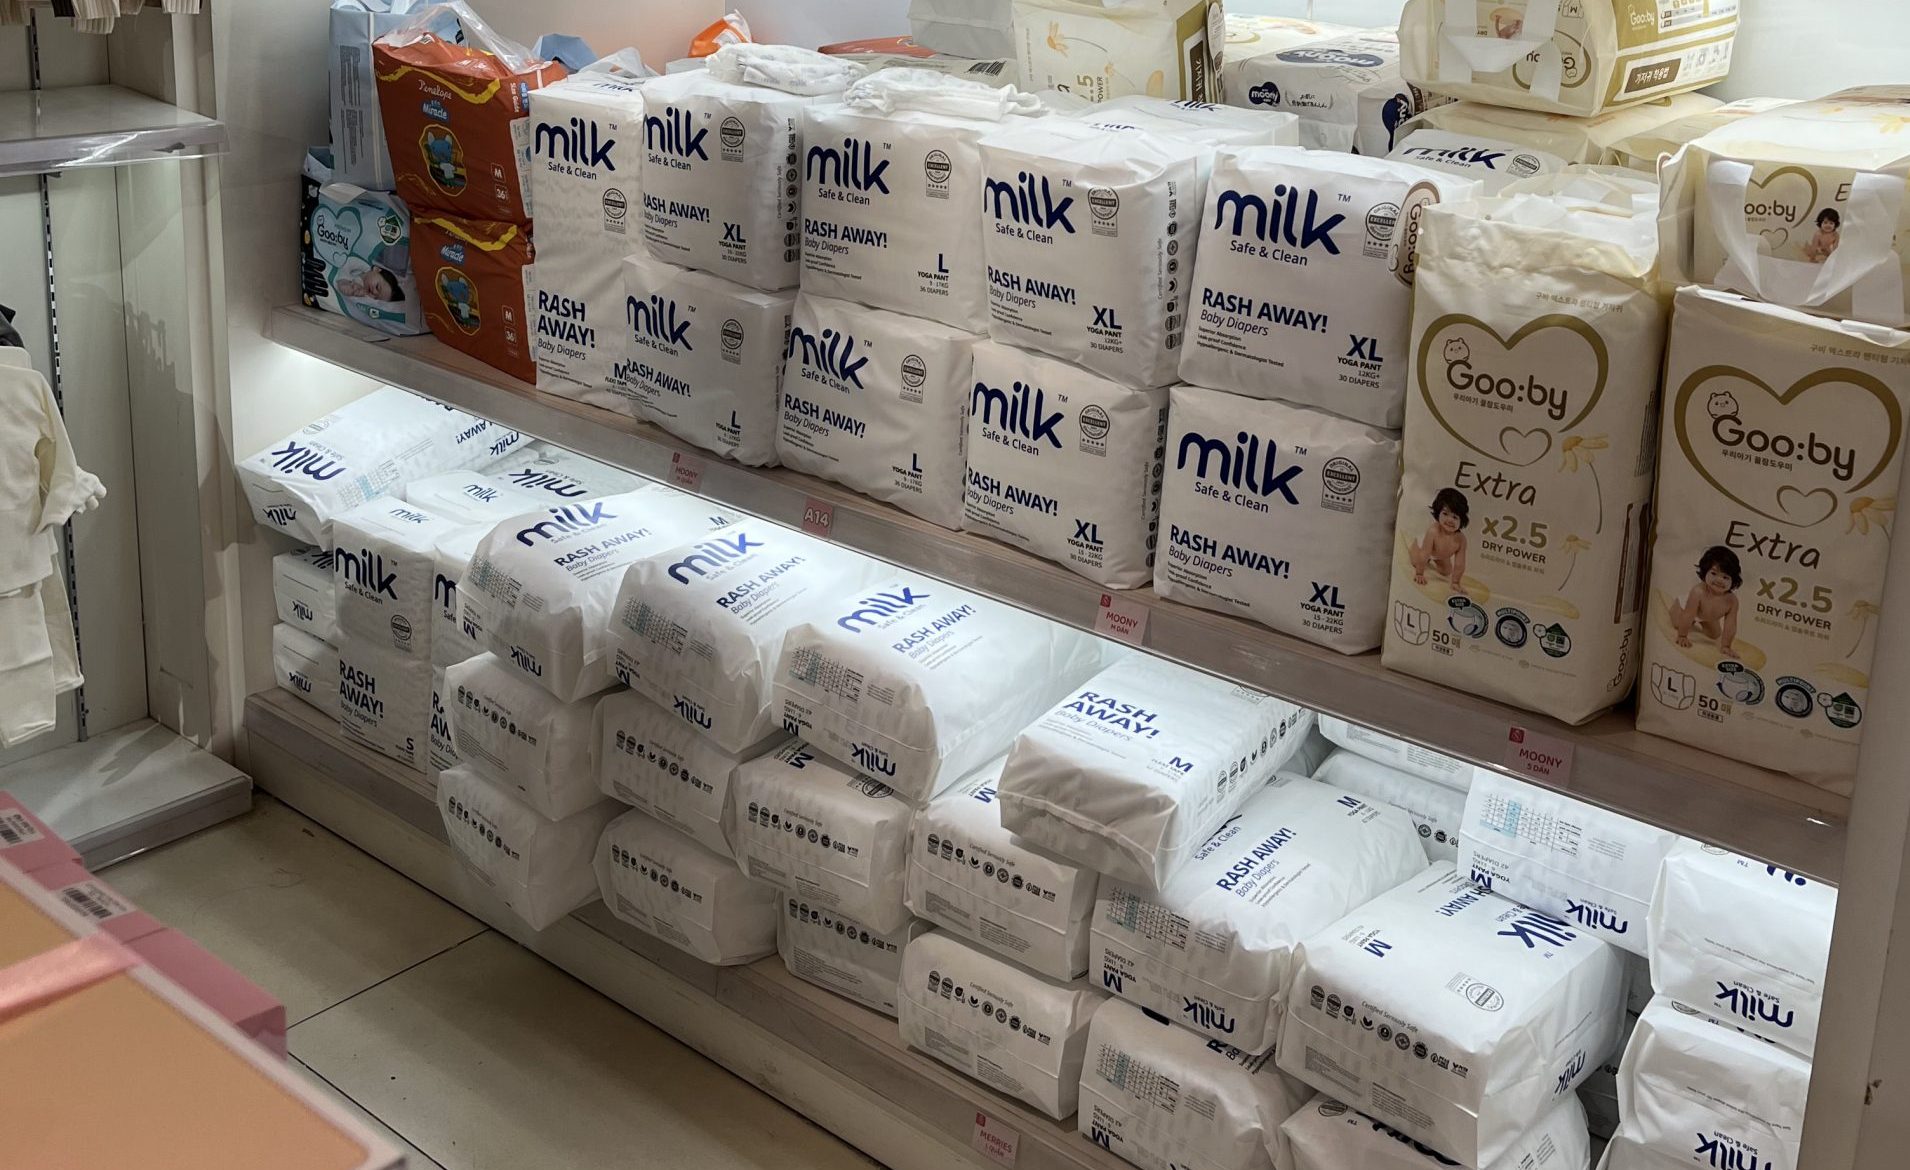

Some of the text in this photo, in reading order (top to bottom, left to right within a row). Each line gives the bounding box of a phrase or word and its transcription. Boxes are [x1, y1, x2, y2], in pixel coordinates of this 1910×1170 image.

[1630, 11, 1655, 28] Goo:by
[418, 80, 452, 100] Penelope
[1252, 90, 1278, 101] moony
[535, 117, 616, 171] milk
[643, 106, 709, 161] milk
[807, 138, 890, 194] milk
[818, 188, 870, 206] Safe & Clean
[984, 171, 1076, 234] milk
[1214, 184, 1346, 255] milk
[1744, 200, 1796, 223] oo:by
[317, 224, 349, 250] Goo:by
[724, 222, 746, 244] XL
[804, 218, 888, 248] RASH AWAY!
[804, 238, 848, 254] Baby Diapers
[938, 254, 949, 274] L
[1230, 240, 1308, 266] Safe & Clean
[988, 266, 1076, 305] RASH AWAY!
[990, 286, 1036, 309] Baby Diapers
[538, 290, 586, 322] RASH
[1092, 306, 1122, 330] XL
[1203, 288, 1328, 334] RASH AWAY!
[538, 315, 595, 348] AWAY!
[627, 294, 693, 350] milk
[1087, 326, 1122, 338] YOGA PANT
[1200, 310, 1269, 336] Baby Diapers
[538, 337, 586, 361] Baby Diapers
[789, 327, 869, 390] milk
[1346, 334, 1384, 362] XL
[1338, 356, 1382, 372] YOGA PANT
[1358, 370, 1380, 379] 12KG+
[1338, 374, 1380, 388] 30 DIAPERS
[1446, 359, 1568, 420] Goo:by
[731, 410, 741, 430] L
[784, 393, 867, 438] RASH AWAY!
[784, 410, 830, 438] Baby Diapers
[972, 381, 1064, 448] milk
[982, 427, 1039, 456] Safe & Clean
[1712, 414, 1856, 481] Goo:by
[271, 441, 346, 480] milk
[912, 453, 923, 473] L
[1178, 431, 1304, 506] milk
[509, 468, 588, 498] milk
[968, 466, 1058, 516] RASH AWAY!
[1454, 461, 1537, 507] Extra
[1194, 482, 1269, 513] Safe & Clean
[516, 502, 618, 547] milk
[804, 508, 829, 527] A14
[1074, 519, 1104, 545] XL
[1482, 516, 1548, 548] x2.5
[1724, 520, 1822, 570] Extra
[668, 533, 764, 586] milk
[1169, 545, 1234, 578] Baby Diapers
[1171, 524, 1290, 580] RASH AWAY!
[1482, 540, 1504, 554] DRY
[1506, 546, 1546, 564] POWER
[336, 549, 398, 600] milk
[1309, 582, 1345, 609] XL
[1756, 576, 1833, 614] x2.5
[838, 587, 930, 634] milk
[1106, 612, 1138, 628] MOONY
[1300, 602, 1344, 618] YOGA PANT
[1326, 616, 1344, 626] 22KG
[1407, 614, 1415, 628] L
[1756, 603, 1781, 618] DRY
[1784, 610, 1832, 631] POWER
[1432, 630, 1450, 646] 50
[511, 646, 542, 676] milk
[1611, 628, 1632, 686] Goo:by
[1668, 677, 1677, 692] L
[674, 695, 711, 730] milk
[1079, 691, 1158, 722] RASH
[1698, 694, 1720, 712] 50
[1062, 701, 1160, 739] AWAY!
[406, 738, 414, 750] S
[1519, 748, 1562, 768] MOONY
[852, 742, 896, 777] milk
[1168, 756, 1194, 773] M
[974, 787, 997, 804] M
[1194, 826, 1241, 861] Safe & Clean
[1216, 828, 1297, 891] RASH AWAY!
[1566, 900, 1628, 934] milk
[1364, 938, 1392, 958] M
[1103, 970, 1122, 994] M
[1104, 962, 1136, 983] YOGA PANT
[1183, 996, 1236, 1034] milk
[1362, 1000, 1383, 1015] Certified
[1716, 980, 1794, 1028] milk
[1091, 1126, 1110, 1150] M
